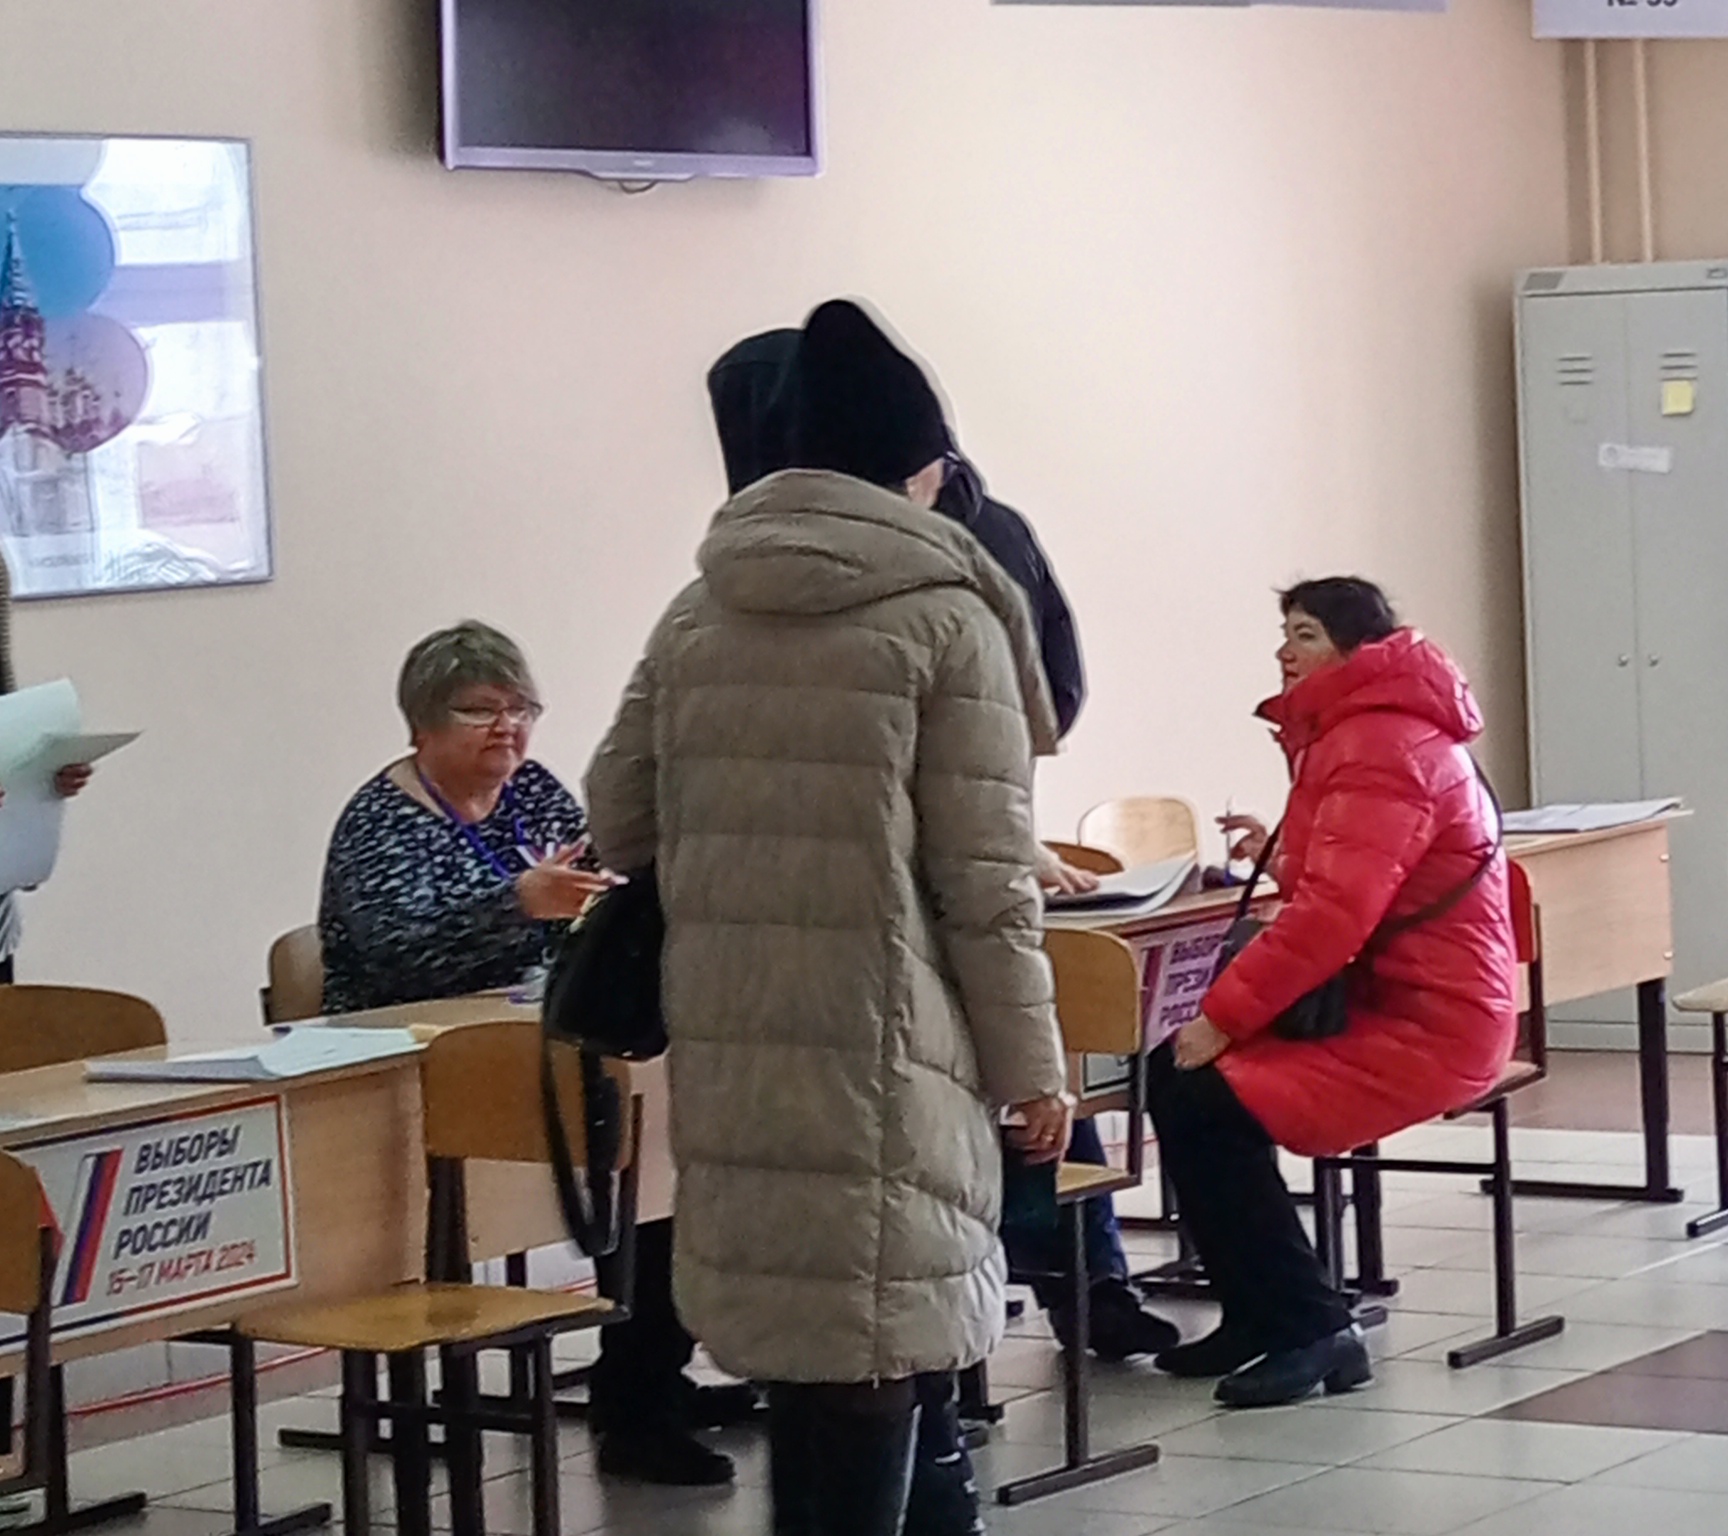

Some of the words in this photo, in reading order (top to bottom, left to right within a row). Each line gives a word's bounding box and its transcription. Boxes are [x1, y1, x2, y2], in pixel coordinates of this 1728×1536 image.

[134, 1125, 241, 1174] ВЫБОРЫ
[123, 1159, 272, 1216] ПРЕЗИДЕНТА
[113, 1212, 212, 1260] РОССИИ
